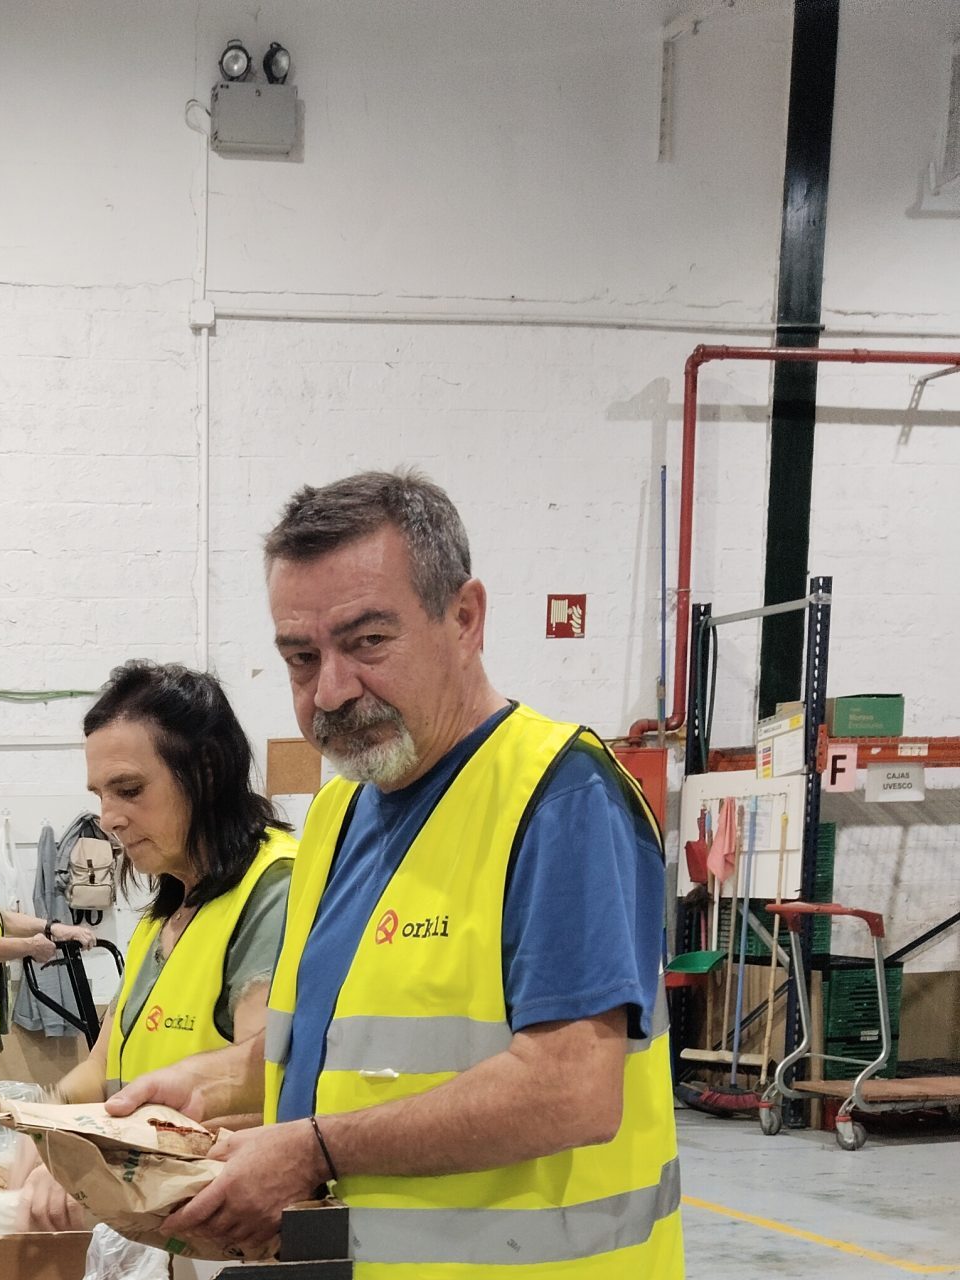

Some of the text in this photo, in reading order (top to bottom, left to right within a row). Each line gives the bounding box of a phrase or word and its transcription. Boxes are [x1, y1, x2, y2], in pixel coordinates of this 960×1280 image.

[830, 754, 847, 785] F
[882, 782, 913, 790] UVESCO
[402, 915, 449, 938] orkli
